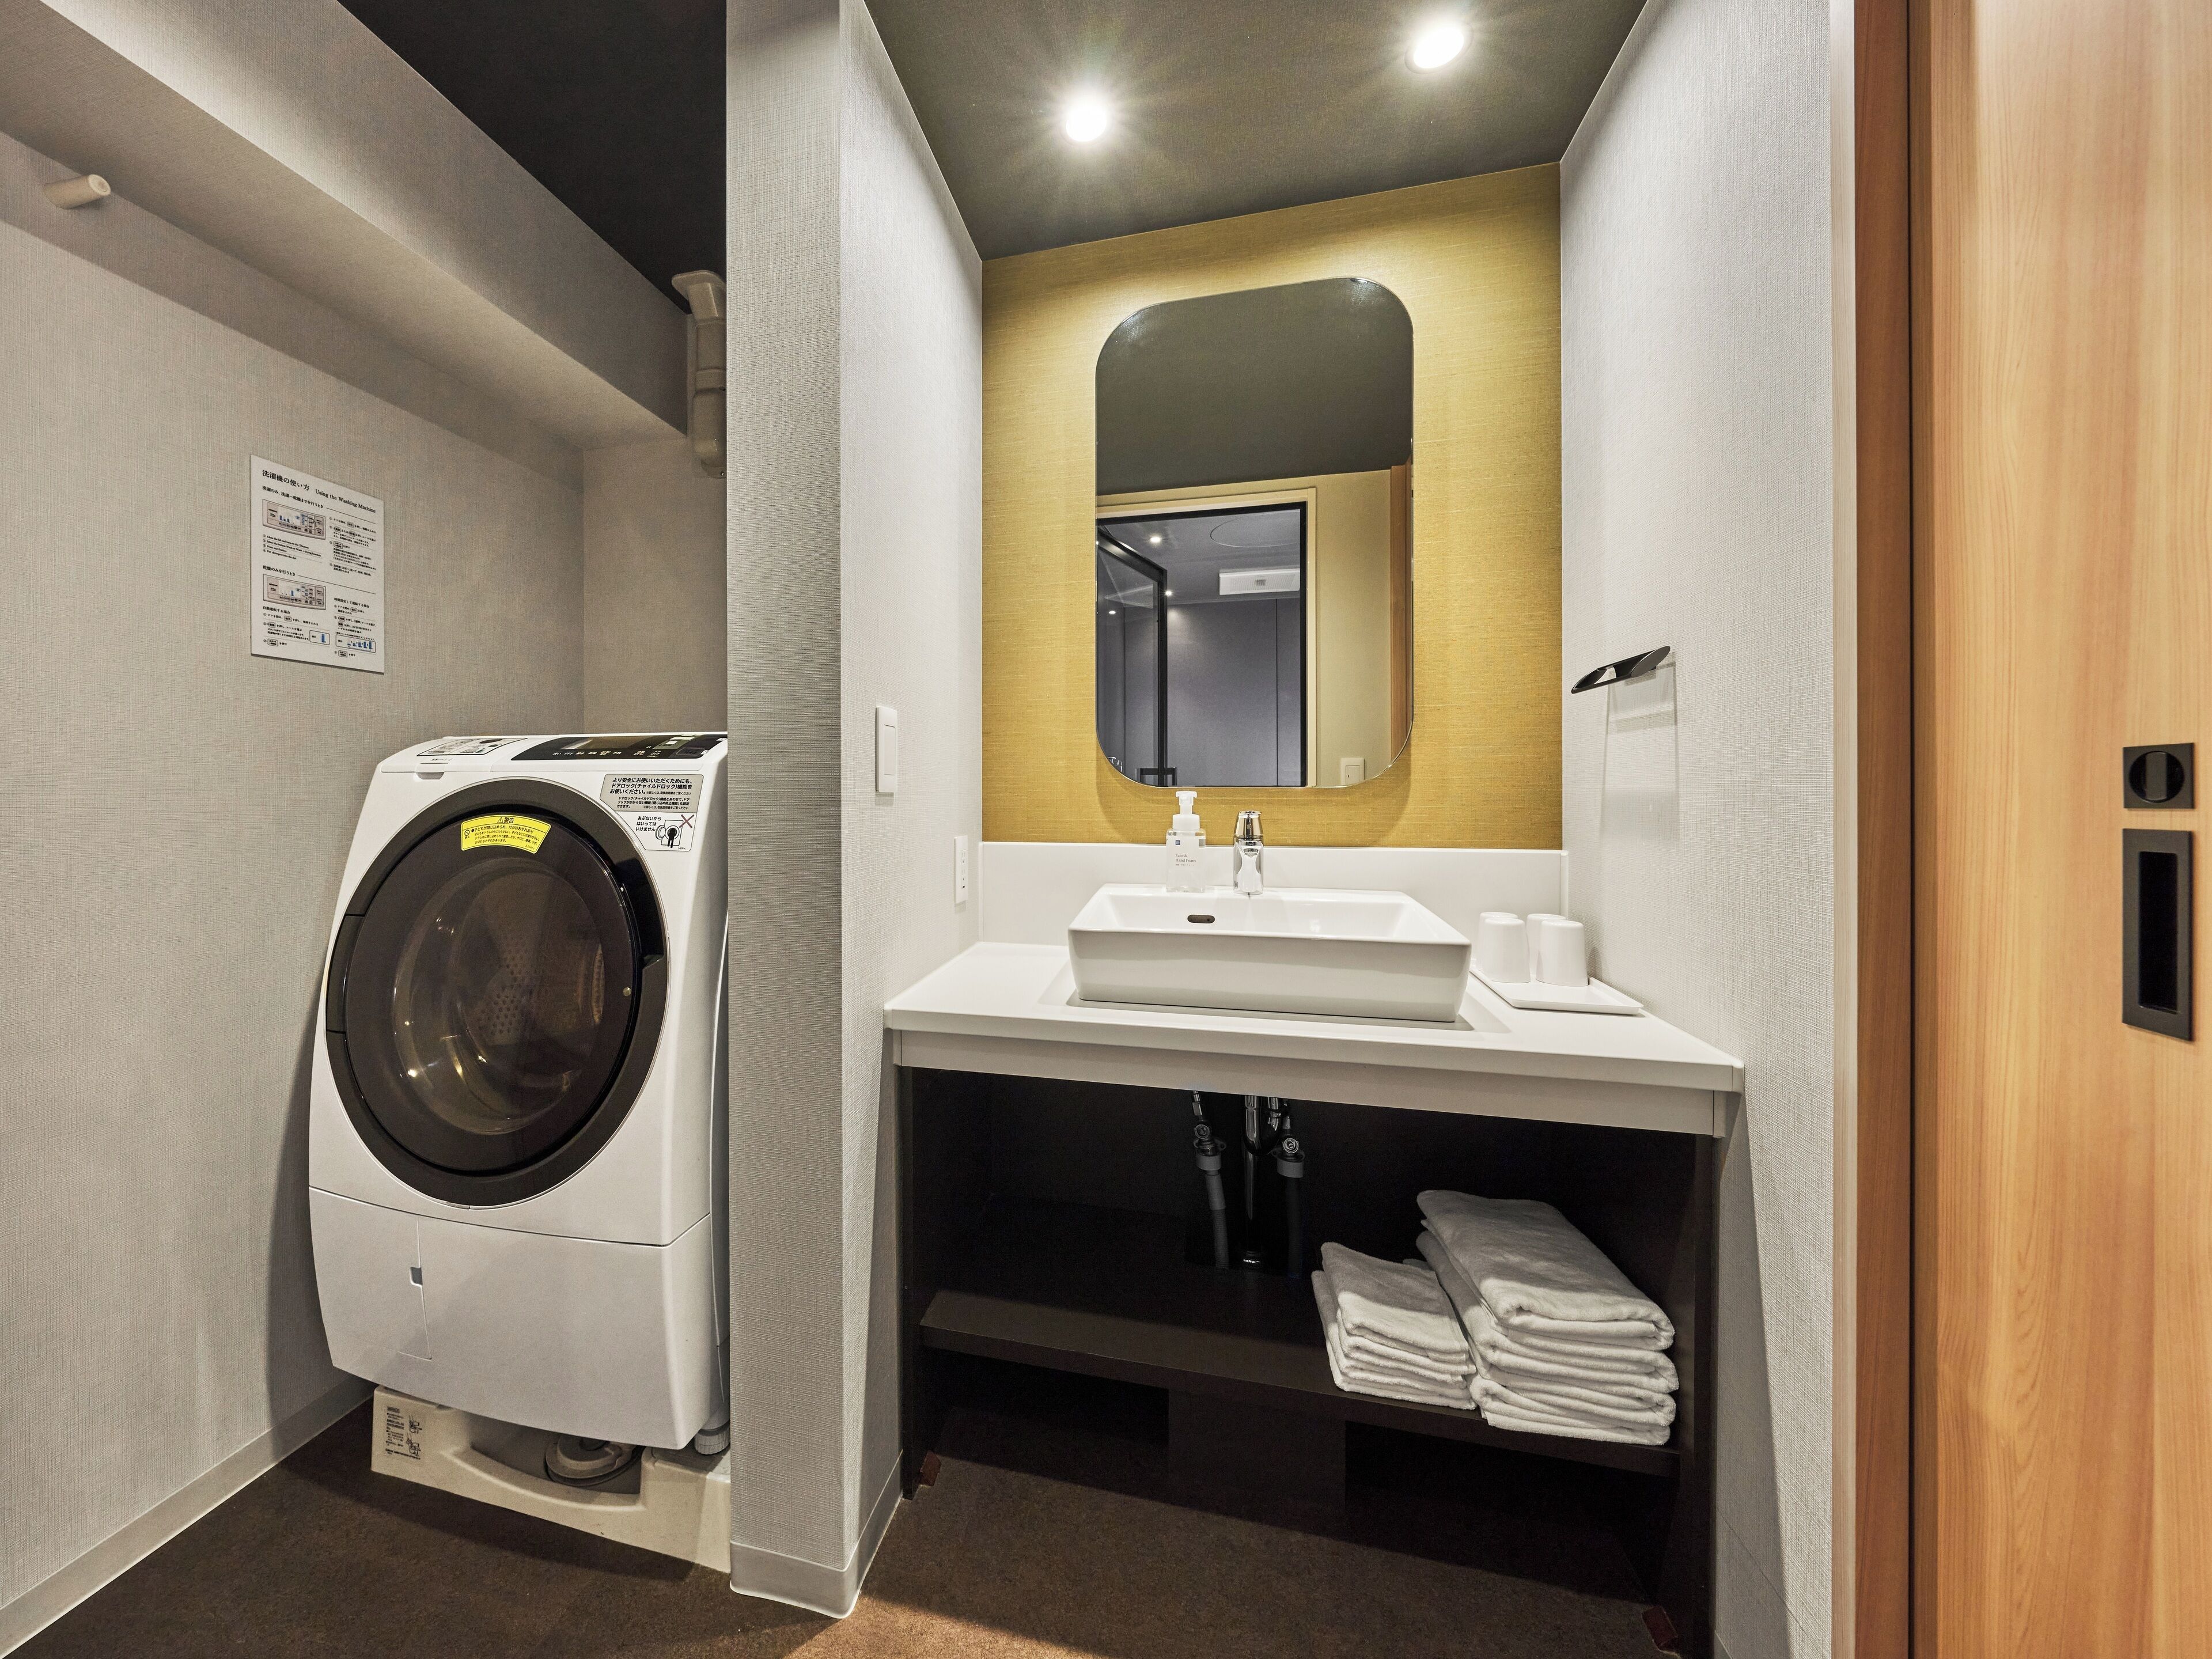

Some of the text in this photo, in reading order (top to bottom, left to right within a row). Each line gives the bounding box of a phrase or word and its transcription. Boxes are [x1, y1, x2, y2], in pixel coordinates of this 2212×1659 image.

[262, 469, 310, 491] 洗濯機の使い方
[315, 488, 329, 498] Using
[338, 497, 357, 507] Washing
[358, 503, 376, 513] Machine
